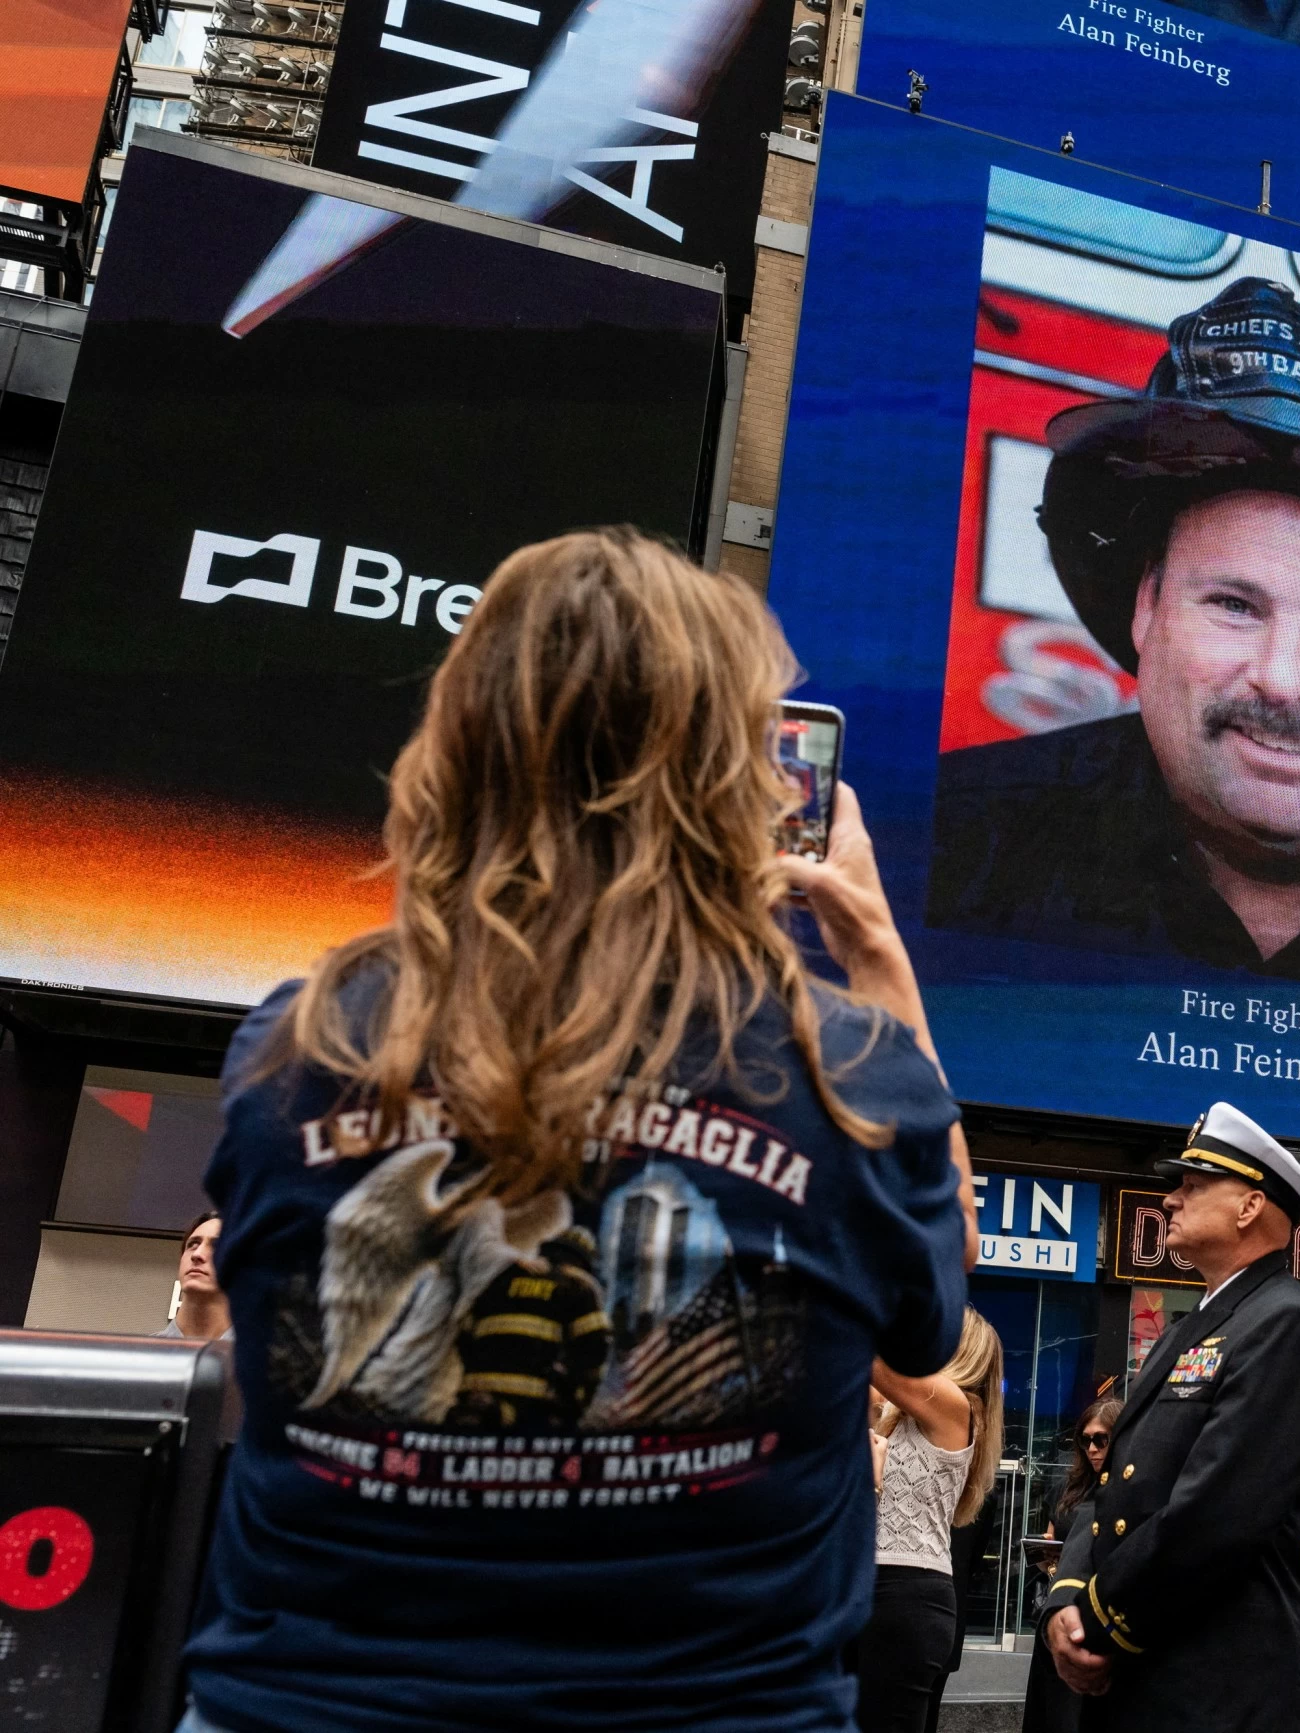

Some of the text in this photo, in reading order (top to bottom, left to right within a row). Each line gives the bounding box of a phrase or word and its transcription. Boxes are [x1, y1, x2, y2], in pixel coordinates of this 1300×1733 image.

[1088, 0, 1205, 44] Fire Fighter
[1057, 13, 1231, 87] Alan Feinberg
[334, 545, 484, 635] Bre
[21, 979, 84, 991] DAKTRONICS
[1181, 989, 1235, 1020] Fire
[1137, 1031, 1220, 1071] Alan
[443, 1456, 554, 1483] LADDER
[603, 1438, 754, 1482] BATTALION
[359, 1477, 681, 1508] WE WILL NEVER FORGET
